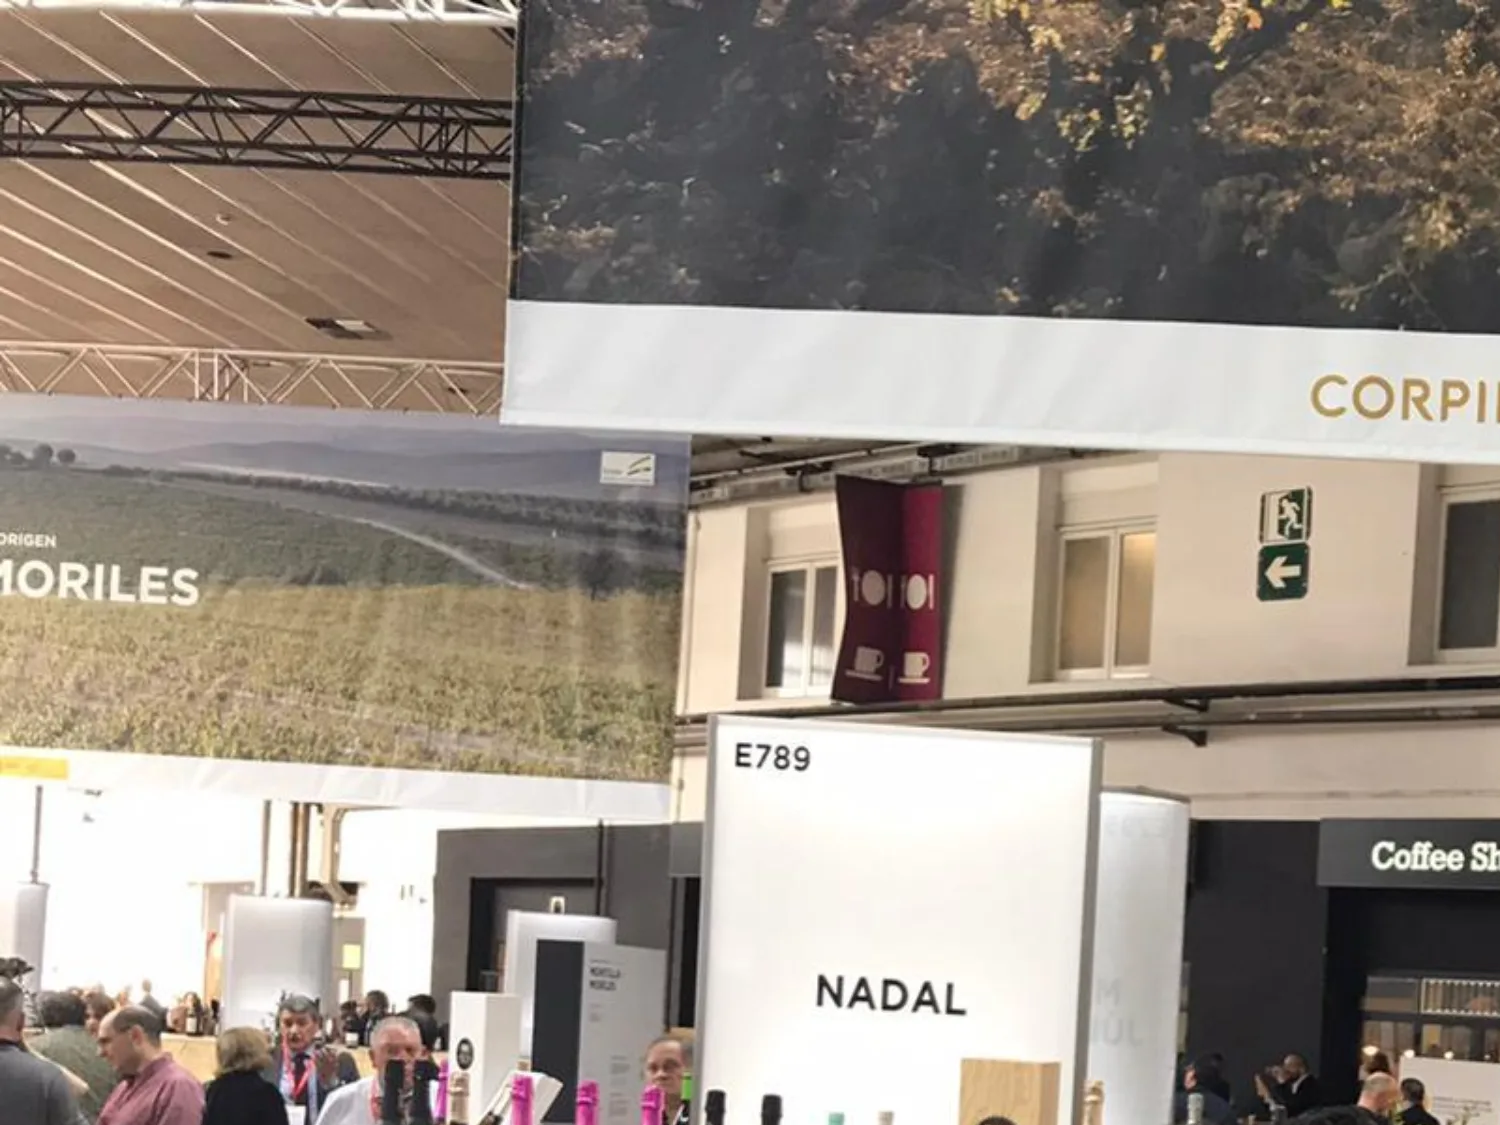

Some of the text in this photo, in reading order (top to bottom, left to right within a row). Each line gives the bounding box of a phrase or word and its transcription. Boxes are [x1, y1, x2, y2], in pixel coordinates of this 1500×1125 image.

[735, 743, 811, 771] E789
[1371, 841, 1464, 871] Coffee
[816, 974, 967, 1016] NADAL
